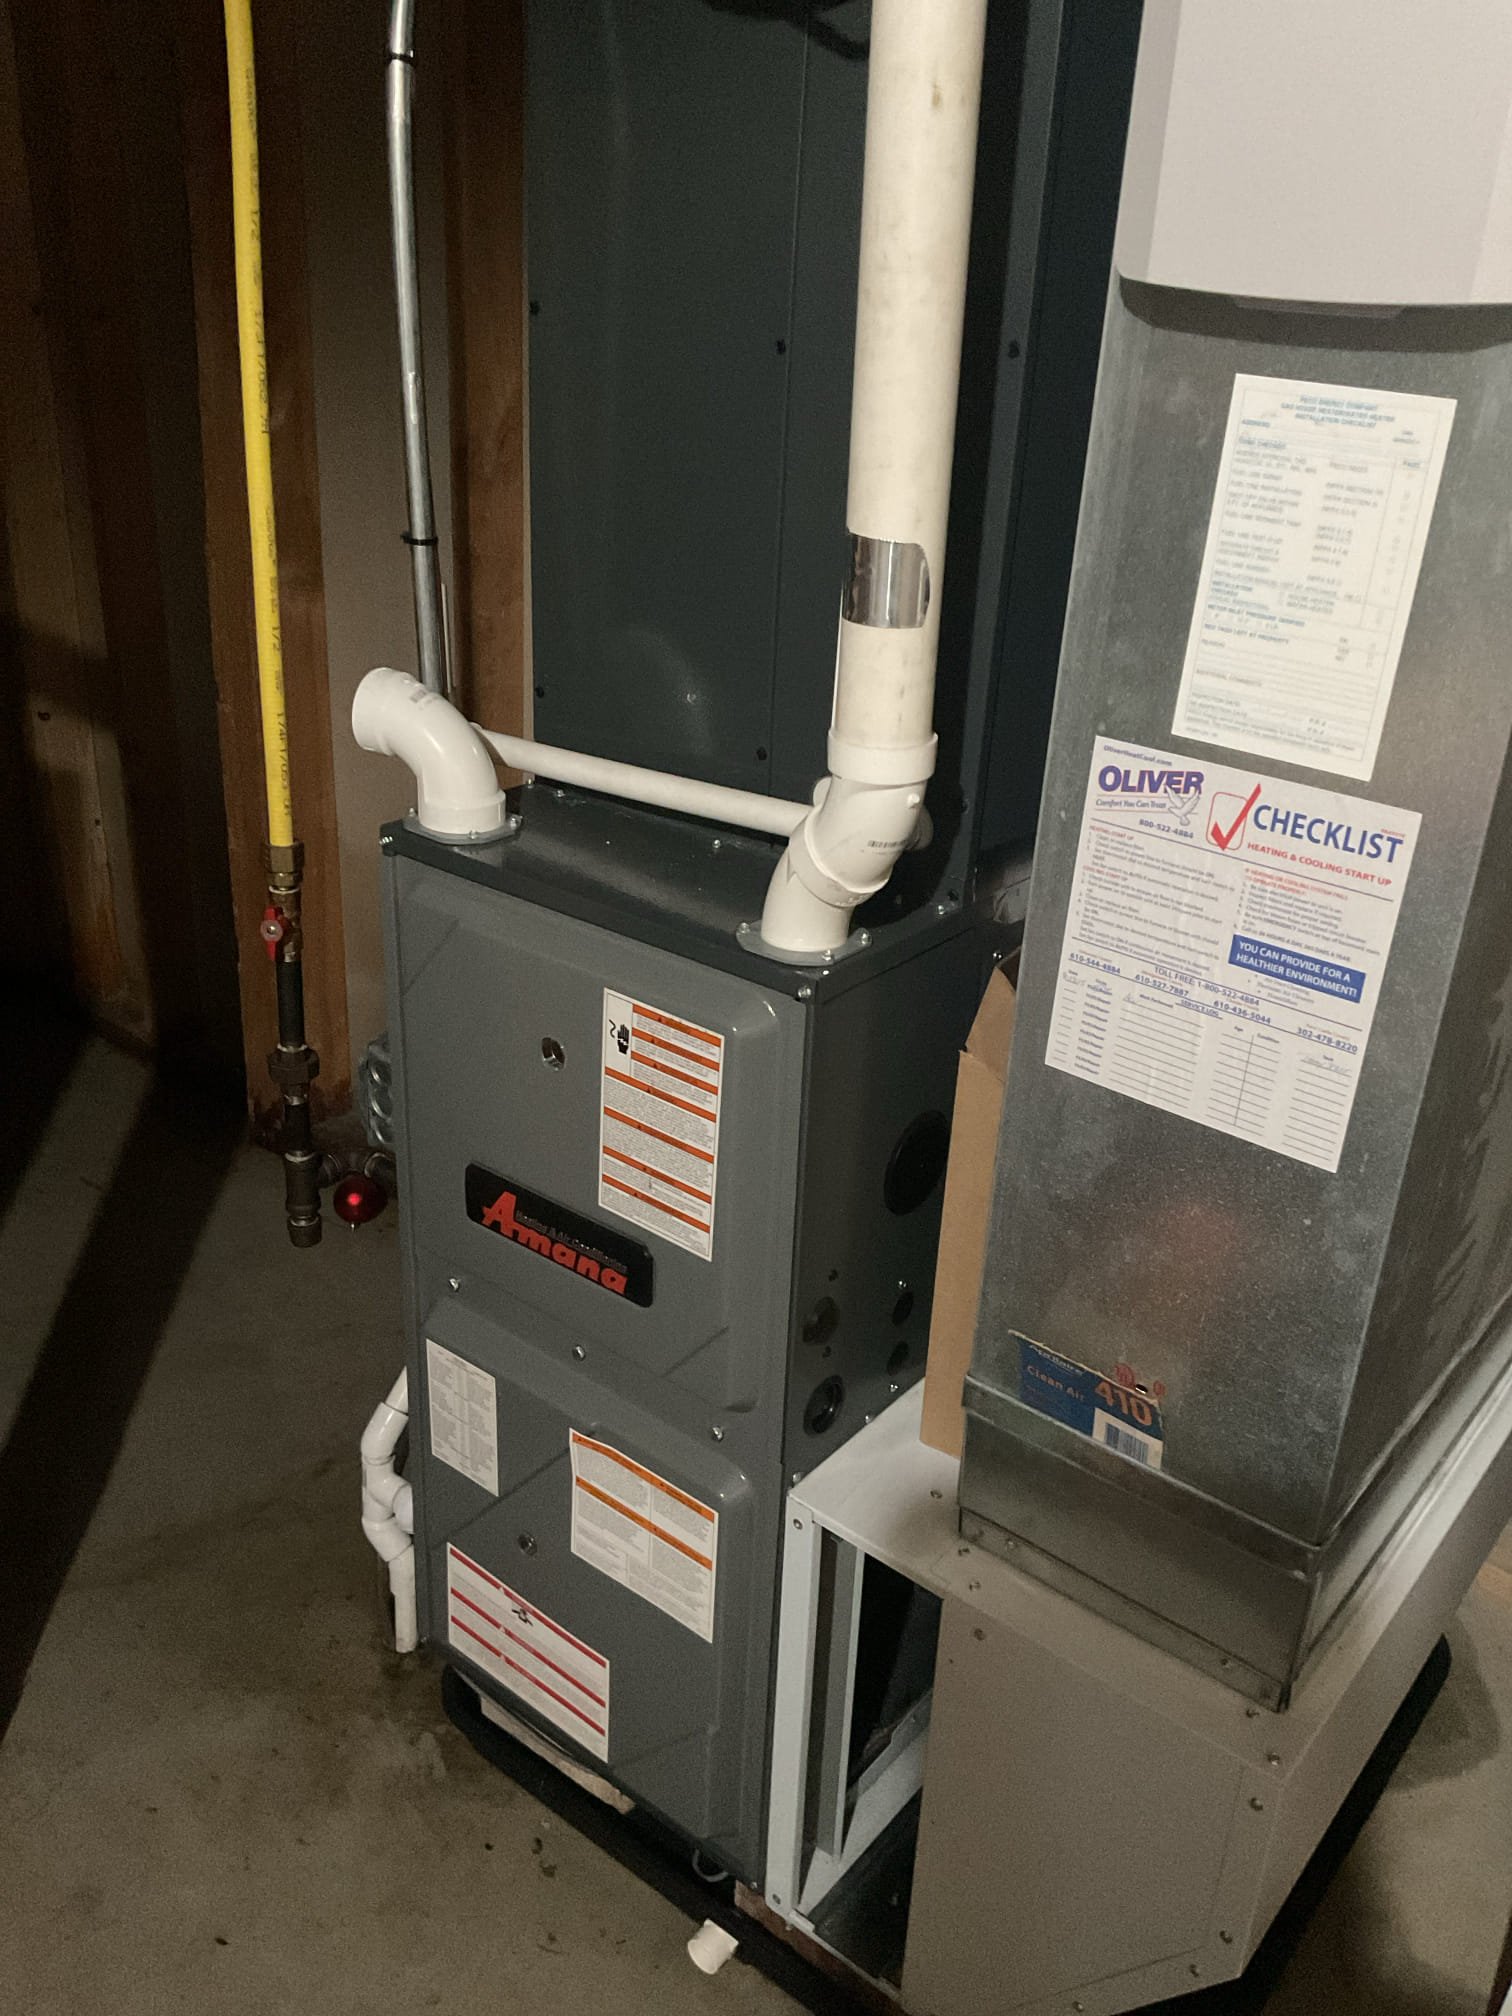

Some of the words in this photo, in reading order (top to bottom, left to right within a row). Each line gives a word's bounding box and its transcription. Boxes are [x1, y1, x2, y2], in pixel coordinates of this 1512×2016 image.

[1097, 765, 1205, 795] OLIVER
[1096, 799, 1123, 809] Comfort
[1123, 800, 1135, 808] You
[1253, 804, 1404, 863] CHECKLIST
[1247, 842, 1288, 859] HEATING
[1289, 853, 1297, 861] &
[1298, 855, 1342, 874] COOLING
[1344, 868, 1375, 882] START
[1377, 876, 1392, 887] UP
[1070, 952, 1120, 974] 610-544-4884
[1235, 952, 1284, 974] HEALTHIER
[1285, 967, 1357, 997] ENVIRONMENT!
[1238, 940, 1257, 953] YOU
[1259, 947, 1279, 960] CAN
[1280, 953, 1321, 973] PROVIDE
[1322, 966, 1342, 979] FOR
[1342, 972, 1351, 982] A
[1135, 973, 1189, 996] 610-527-7887
[1154, 966, 1172, 978] TOLL
[1174, 973, 1195, 985] FREE:
[1198, 980, 1259, 1006] 1-800-522-4884
[1213, 999, 1271, 1023] 610-436-5044
[1296, 1026, 1358, 1052] 302-478-8220
[481, 1190, 628, 1296] Amana
[1027, 1365, 1064, 1391] Clean
[1094, 1380, 1153, 1426] 410
